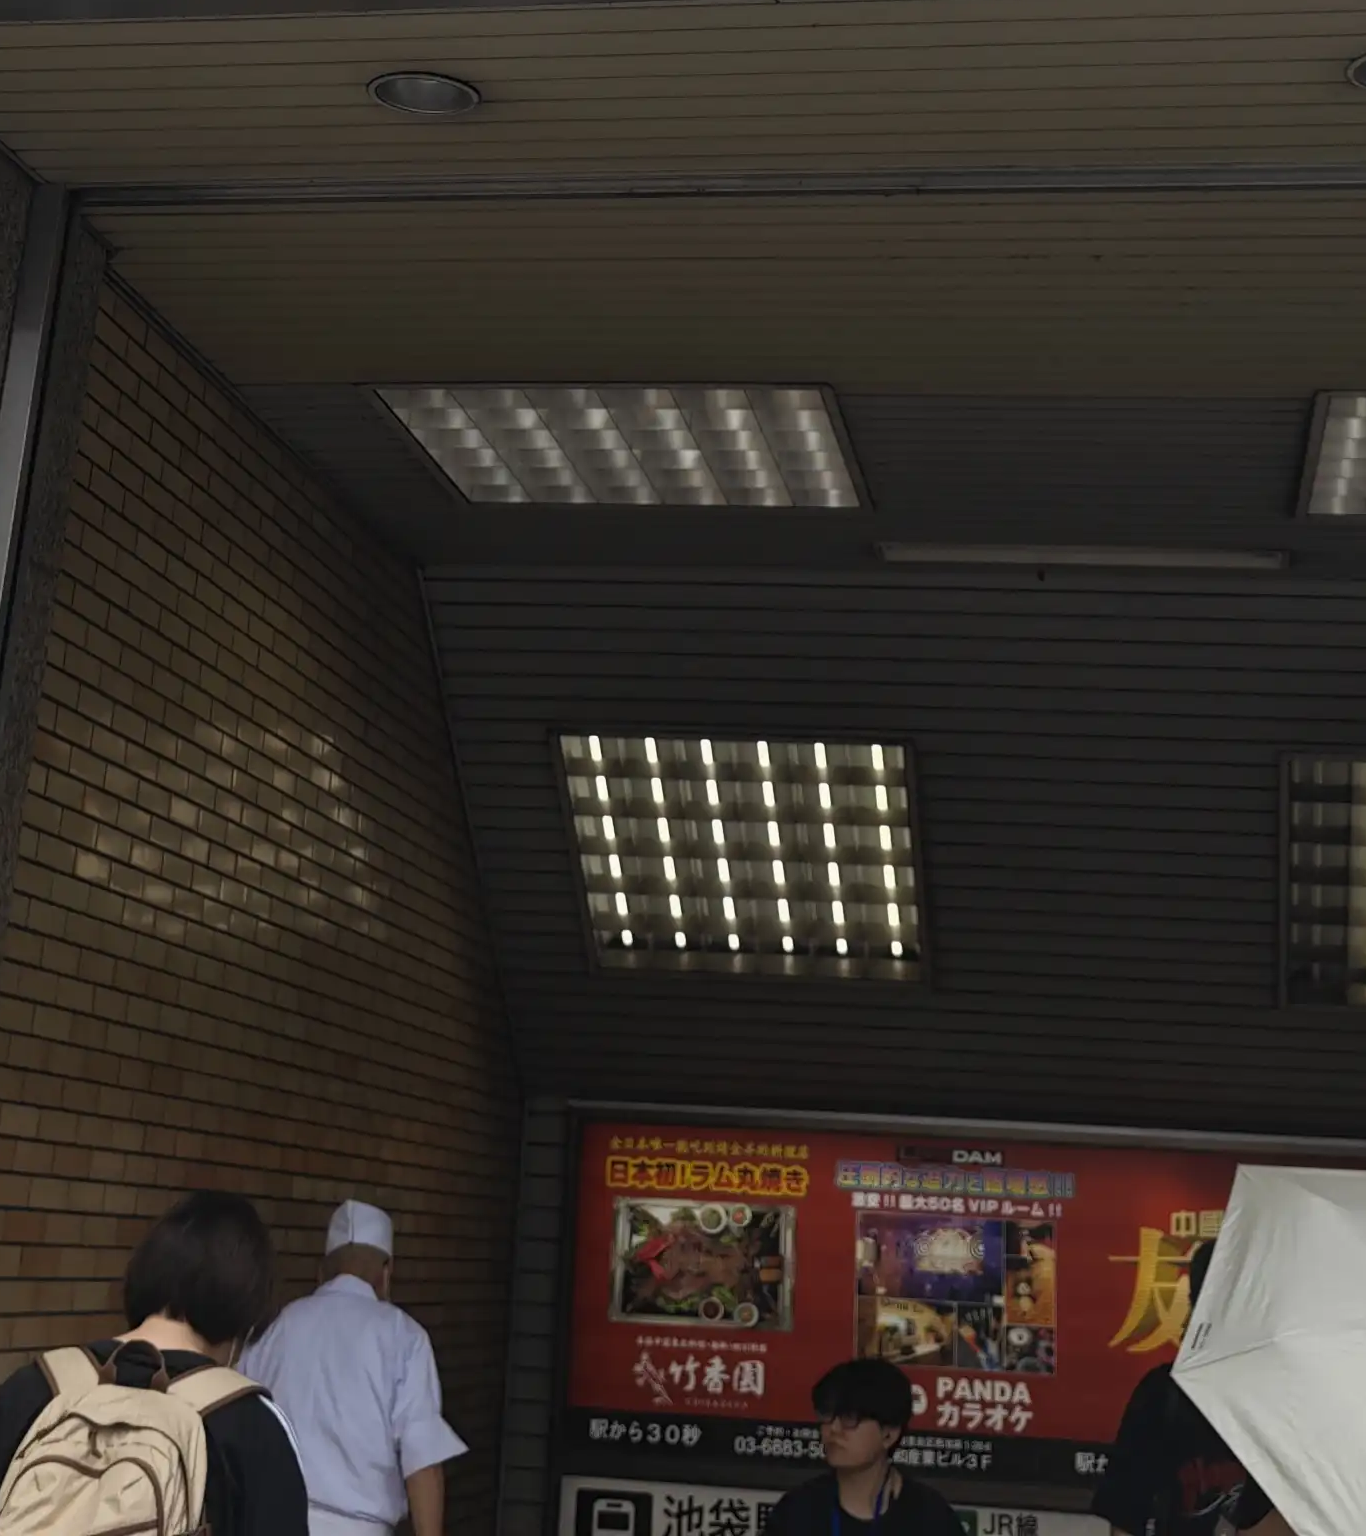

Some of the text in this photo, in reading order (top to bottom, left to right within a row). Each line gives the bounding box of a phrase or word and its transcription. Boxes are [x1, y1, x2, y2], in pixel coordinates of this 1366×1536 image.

[951, 1149, 1004, 1165] DAM
[968, 1198, 999, 1215] VIP
[936, 1377, 1033, 1405] PANDA
[936, 1403, 1034, 1433] カラオケ
[589, 1418, 703, 1448] 駅から30秒
[983, 1512, 1039, 1536] JR線
